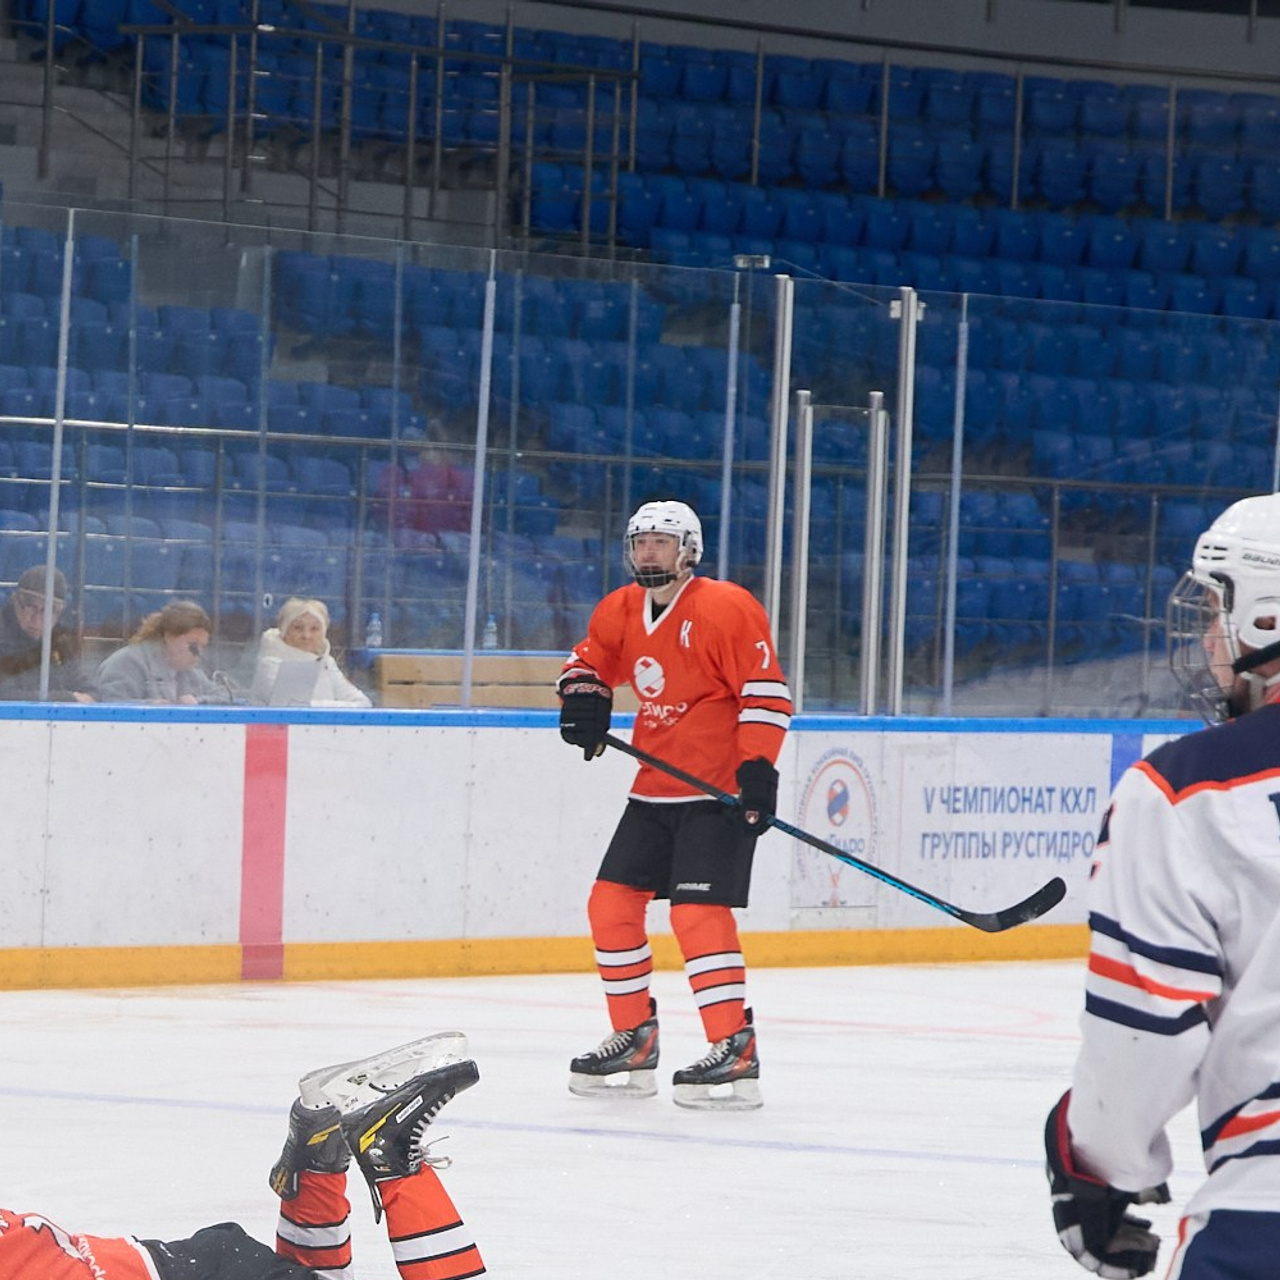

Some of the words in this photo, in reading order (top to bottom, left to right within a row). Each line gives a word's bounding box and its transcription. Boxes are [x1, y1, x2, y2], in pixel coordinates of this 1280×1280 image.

[755, 640, 770, 670] 7
[939, 785, 1056, 814] ЧЕМПИОНАТ
[1060, 786, 1096, 814] КХЛ
[921, 831, 997, 860] ГРУППЫ
[1001, 831, 1096, 863] РУСГИДРО
